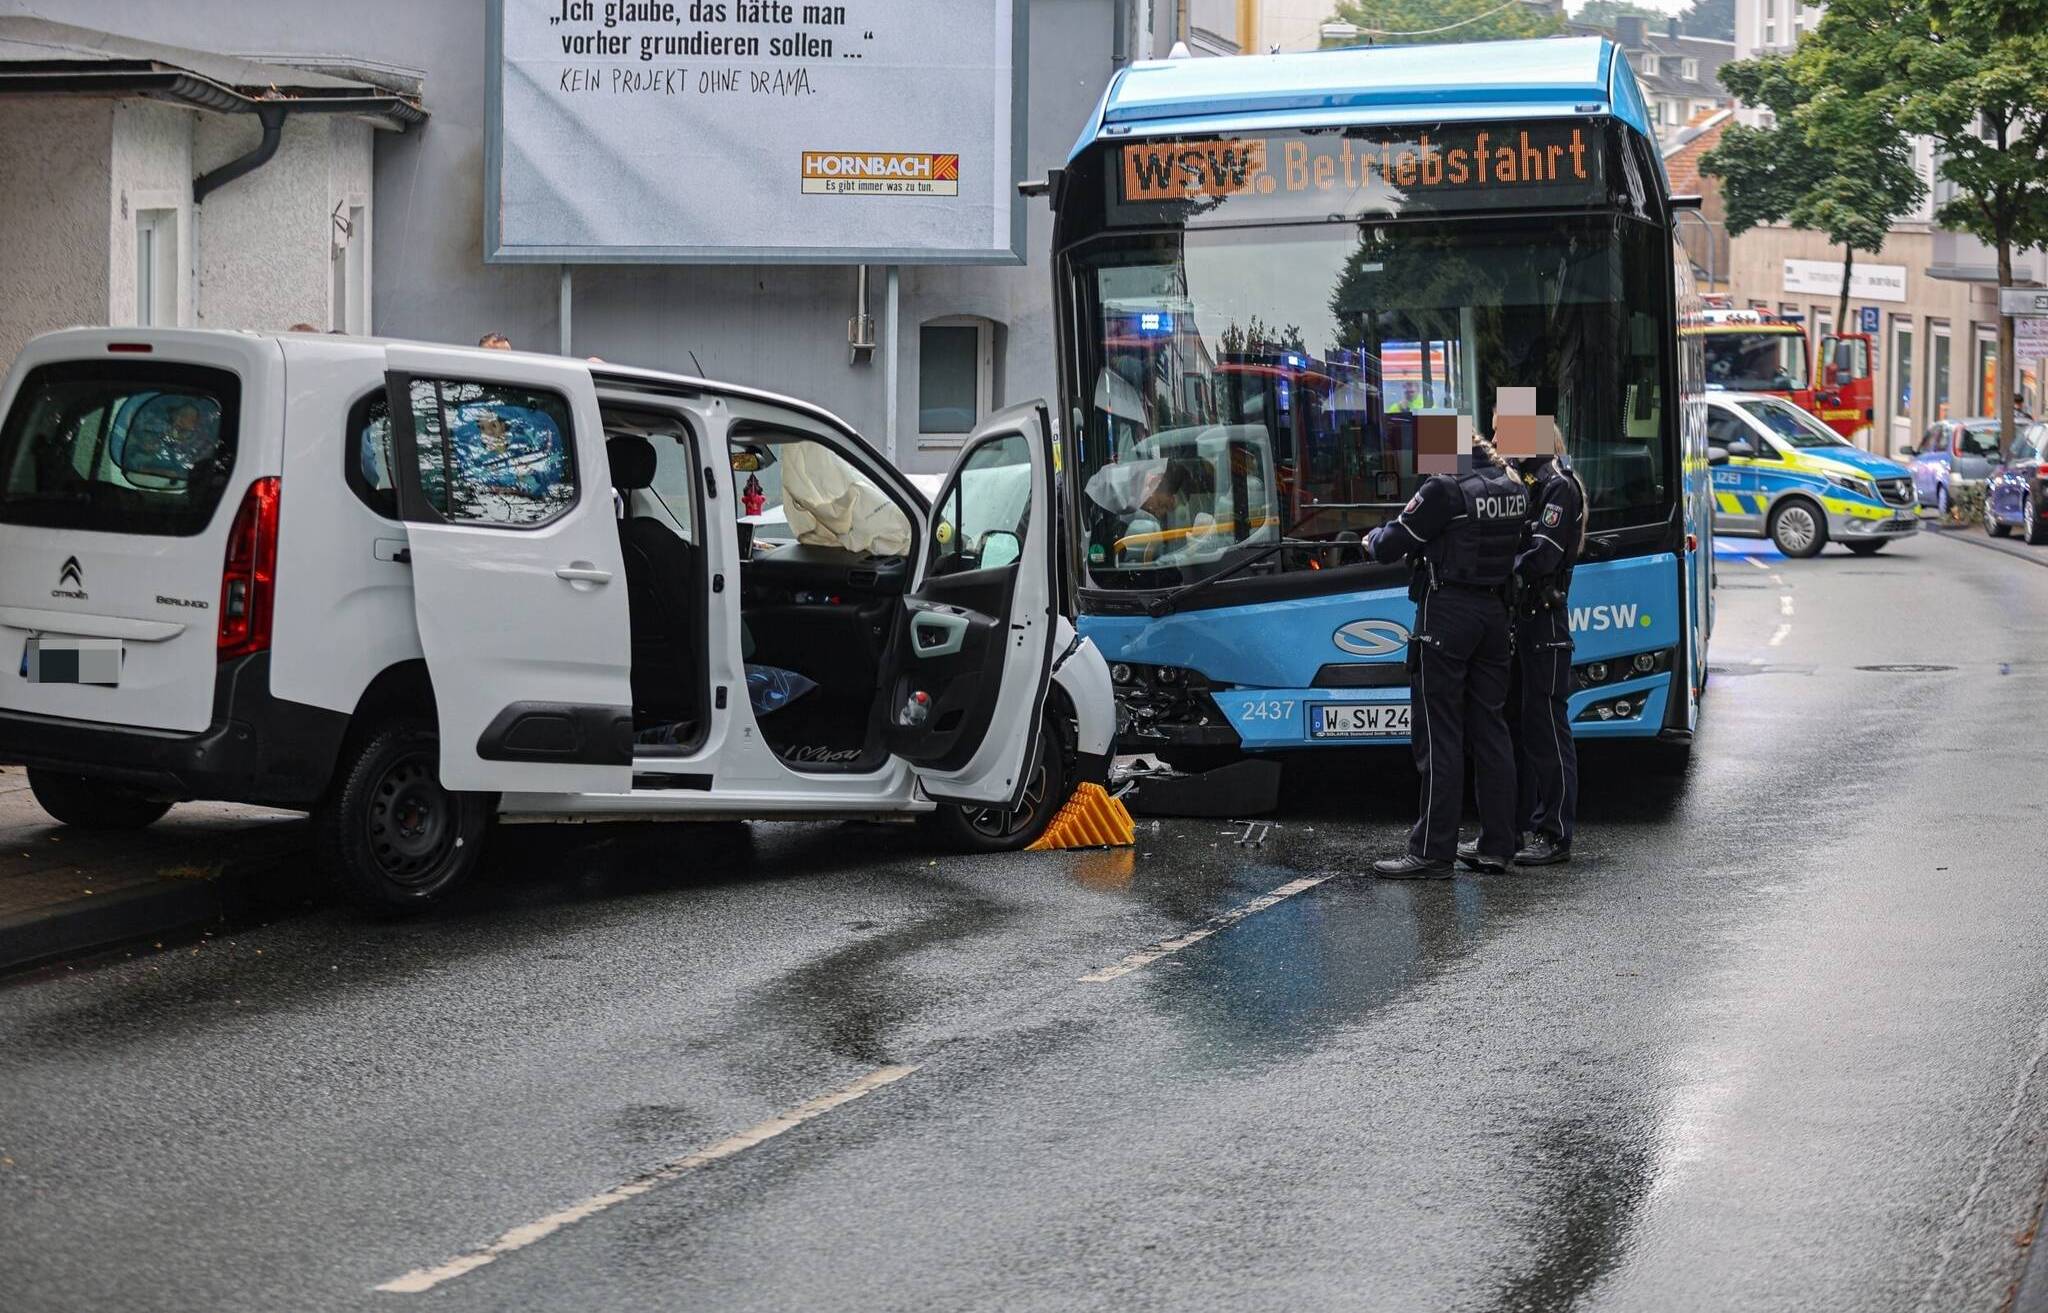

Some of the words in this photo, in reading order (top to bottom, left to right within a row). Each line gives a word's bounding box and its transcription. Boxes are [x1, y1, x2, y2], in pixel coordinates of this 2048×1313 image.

[550, 0, 593, 25] „Ich
[604, 0, 681, 28] glaube,
[689, 0, 727, 22] das
[736, 0, 793, 24] hätte
[803, 5, 845, 25] man
[562, 30, 632, 54] vorher
[640, 30, 759, 62] grundieren
[769, 32, 833, 58] sollen
[560, 68, 601, 93] KEIN
[612, 68, 688, 95] PROJEKT
[698, 68, 742, 94] OHNE
[750, 67, 816, 96] DRAMA.
[806, 155, 930, 177] HORNBACH
[1284, 129, 1588, 192] Betriebsfahrt
[826, 179, 836, 191] Es
[839, 179, 855, 193] gibt
[858, 180, 883, 191] immer
[887, 183, 903, 192] was
[906, 183, 915, 192] zu
[918, 181, 935, 192] tun.
[1475, 494, 1527, 519] POLIZEI
[1242, 700, 1295, 721] 2437
[1325, 709, 1338, 730] W
[1353, 708, 1379, 729] SW
[1385, 707, 1410, 728] 24
